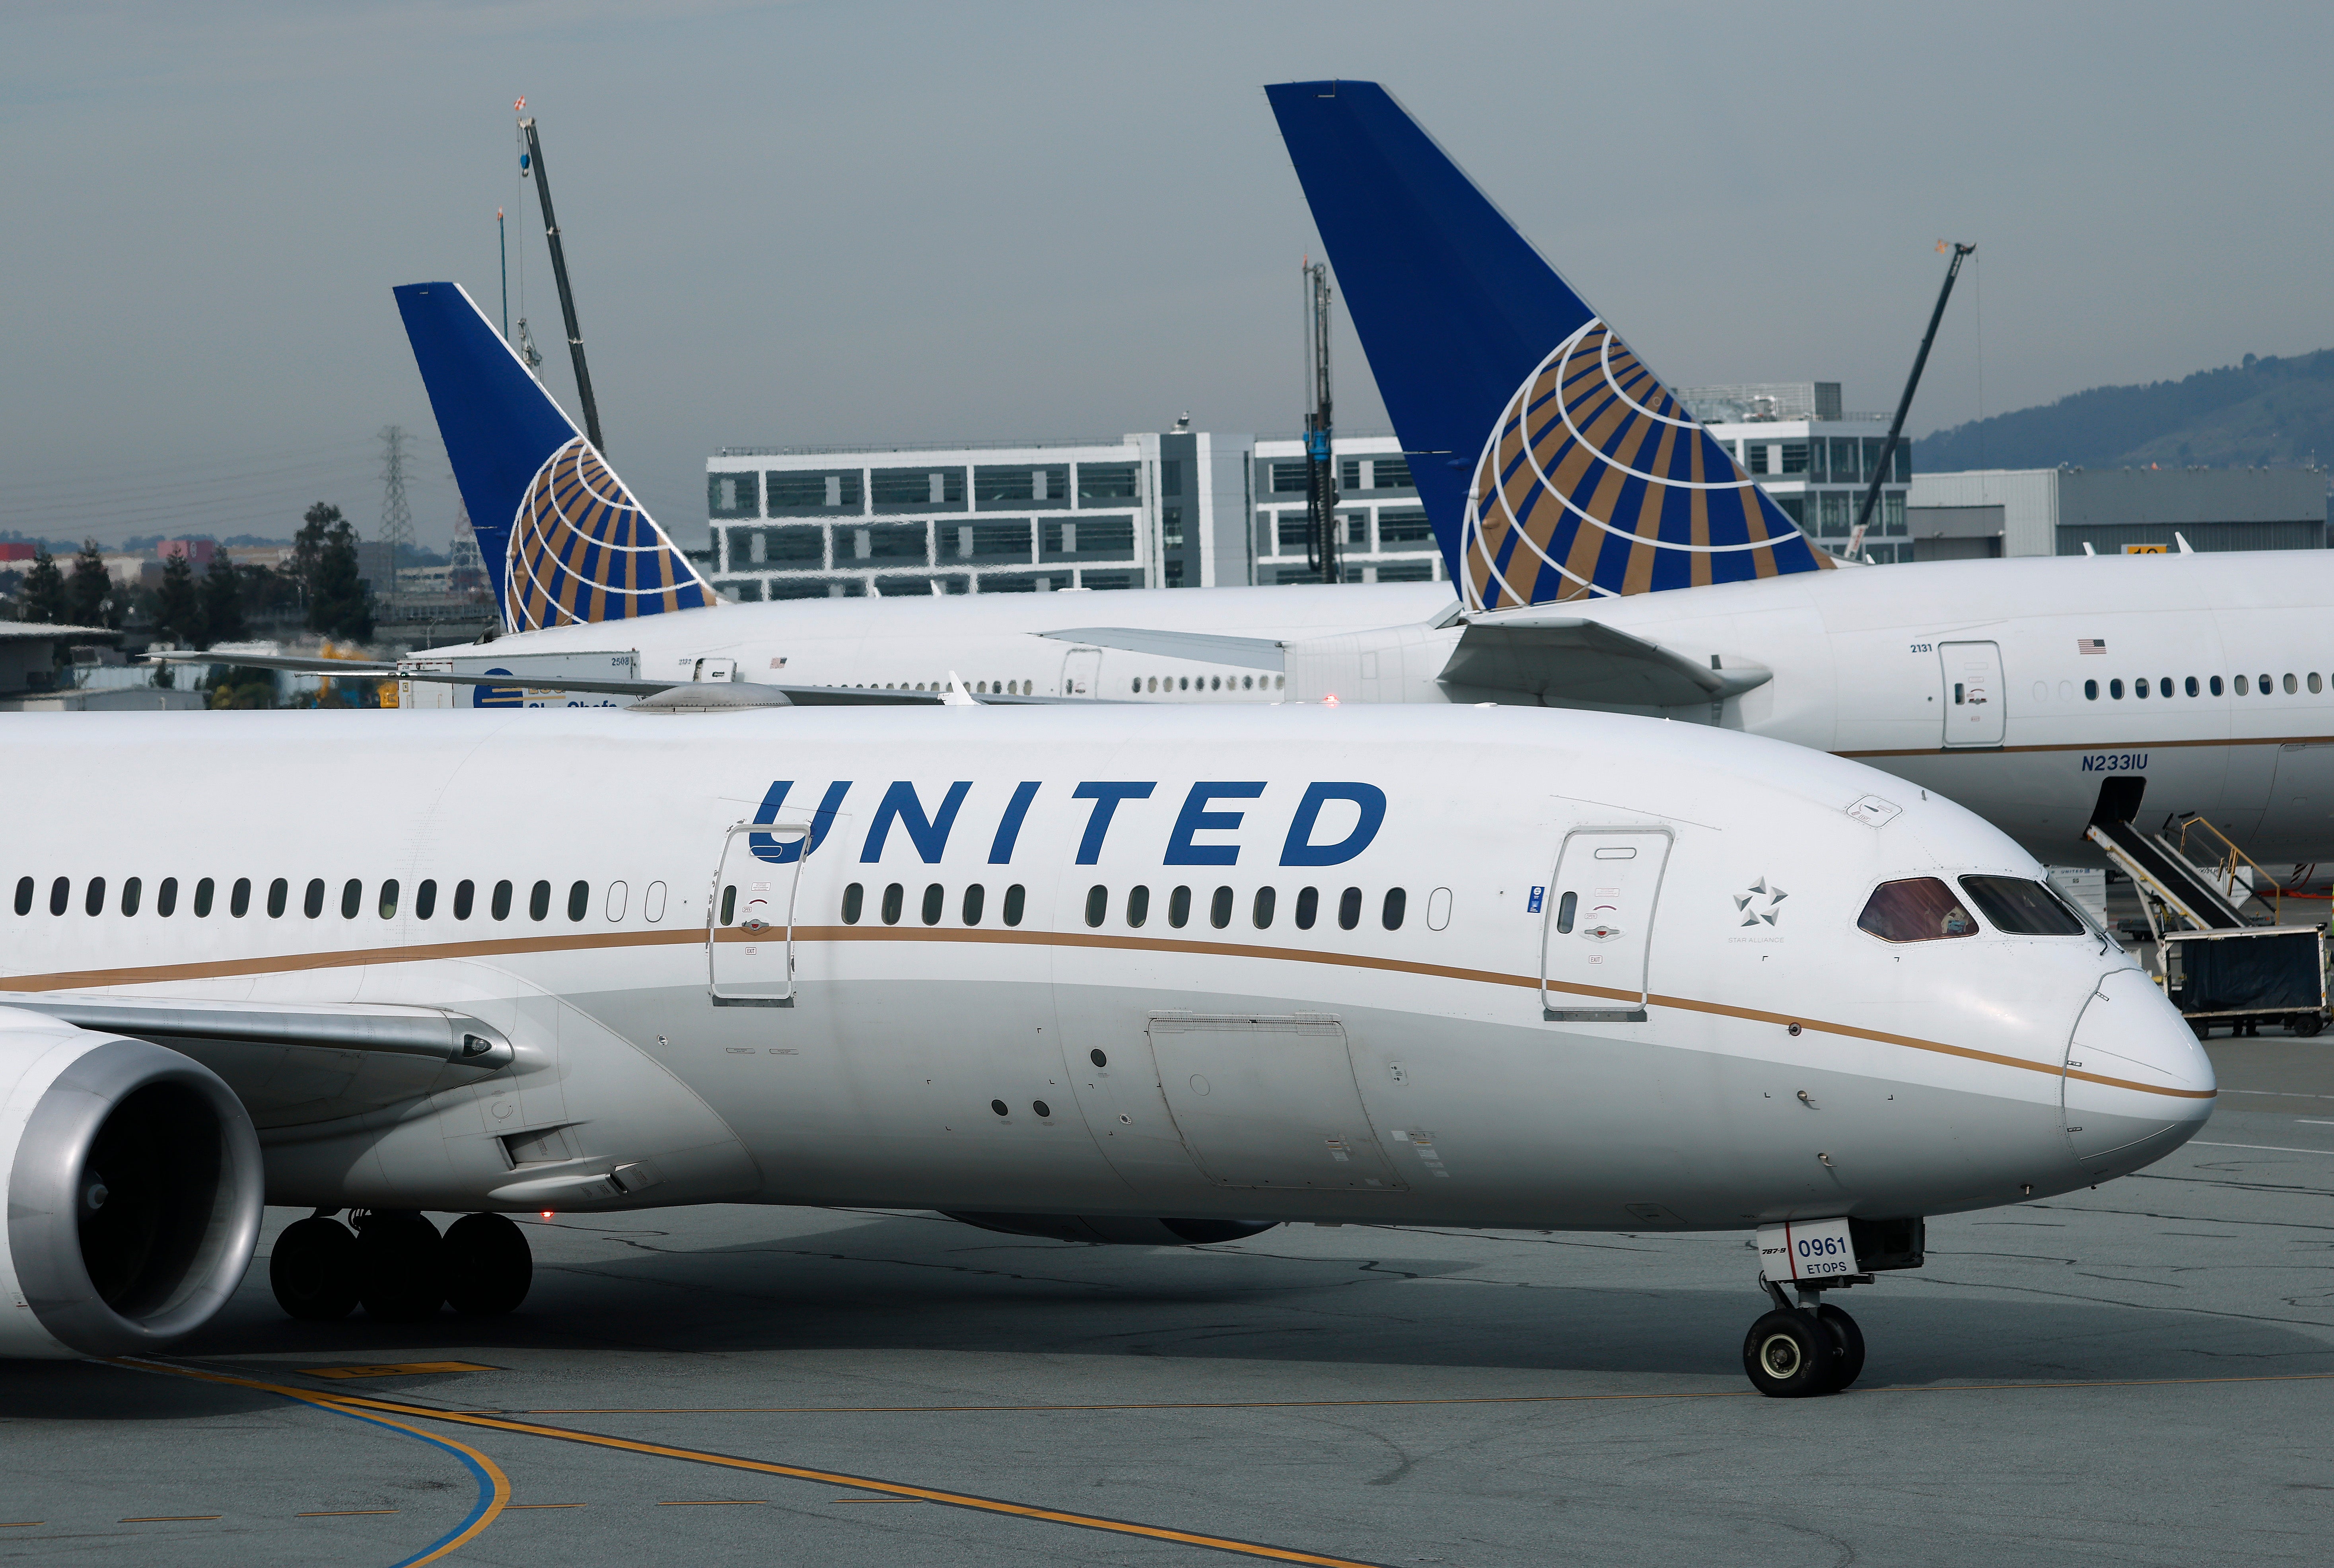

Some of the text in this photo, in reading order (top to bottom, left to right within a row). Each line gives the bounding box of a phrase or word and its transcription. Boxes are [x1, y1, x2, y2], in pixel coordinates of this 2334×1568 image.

[1910, 644, 1932, 653] 2131
[749, 780, 1387, 866] UNITED
[1799, 1237, 1847, 1258] 0961
[1807, 1262, 1847, 1274] ETOPS
